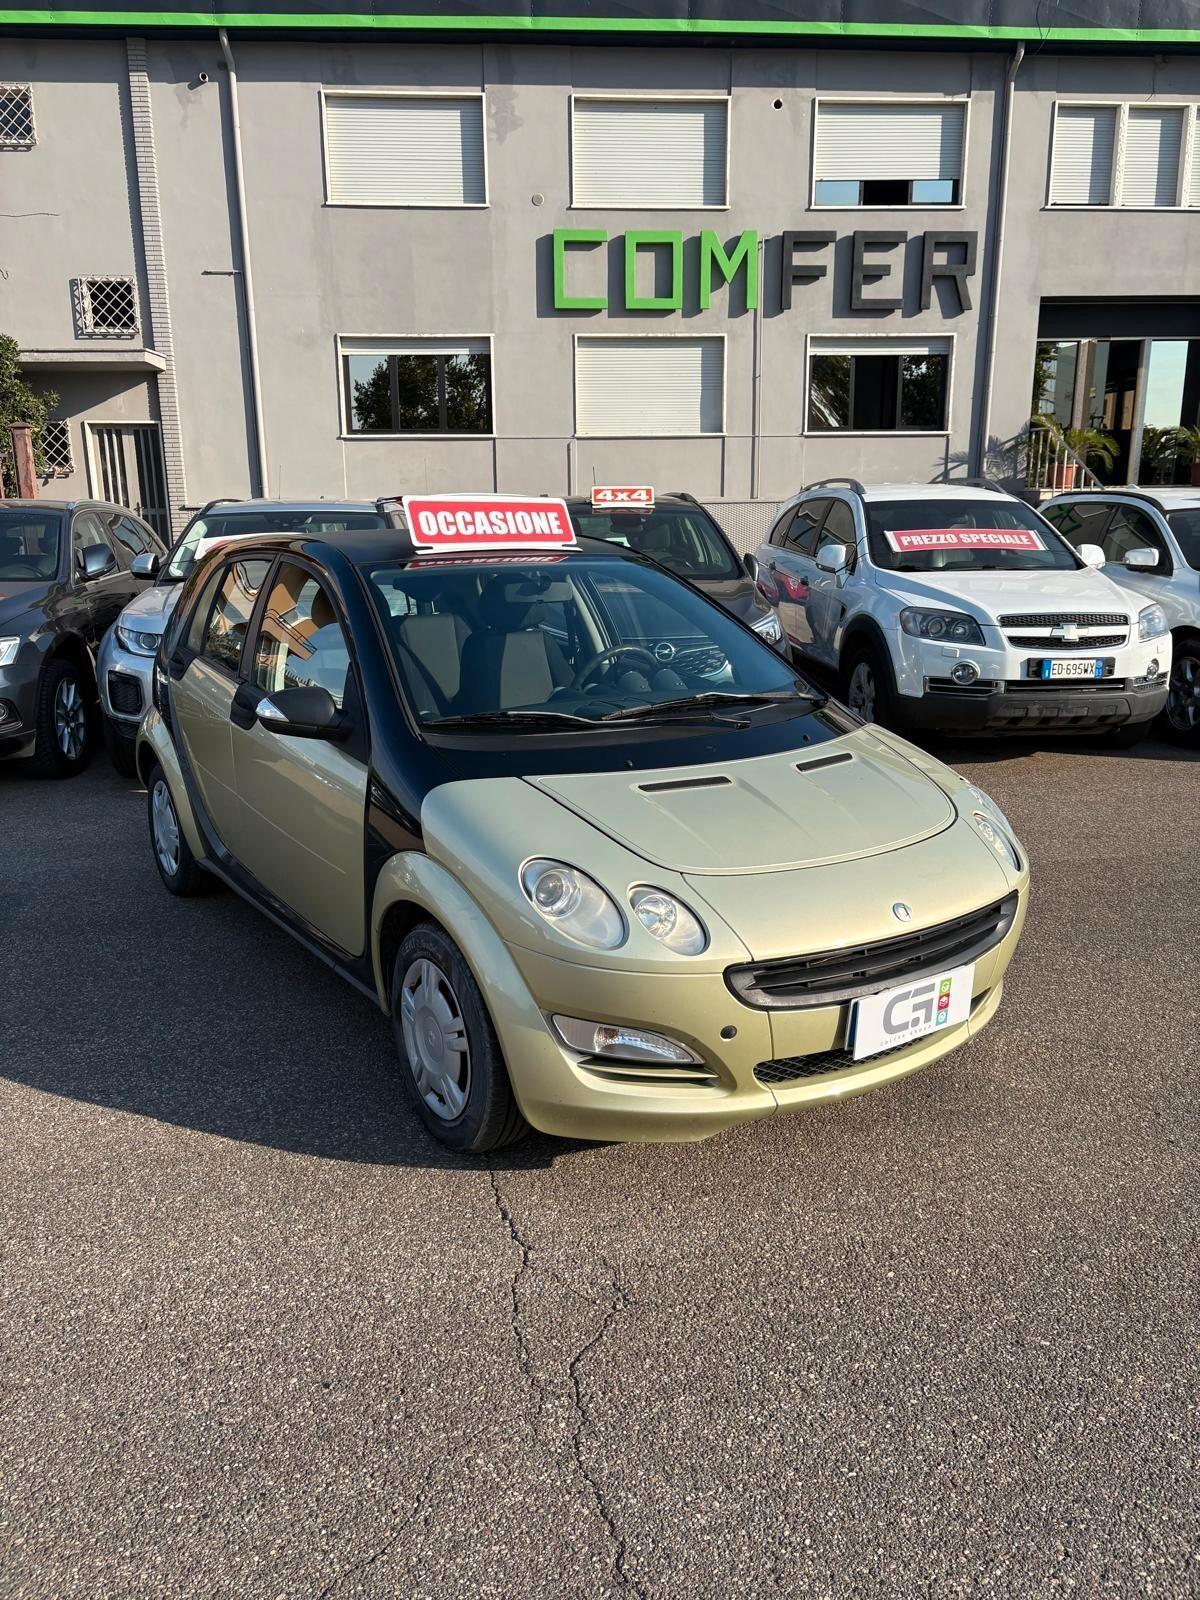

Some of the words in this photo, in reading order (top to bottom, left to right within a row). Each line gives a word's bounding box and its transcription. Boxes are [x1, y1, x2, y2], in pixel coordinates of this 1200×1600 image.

[552, 228, 978, 310] COMFER
[418, 510, 563, 537] OCCASIONE
[900, 533, 959, 546] PREZZO
[959, 532, 1032, 545] SPECIALE
